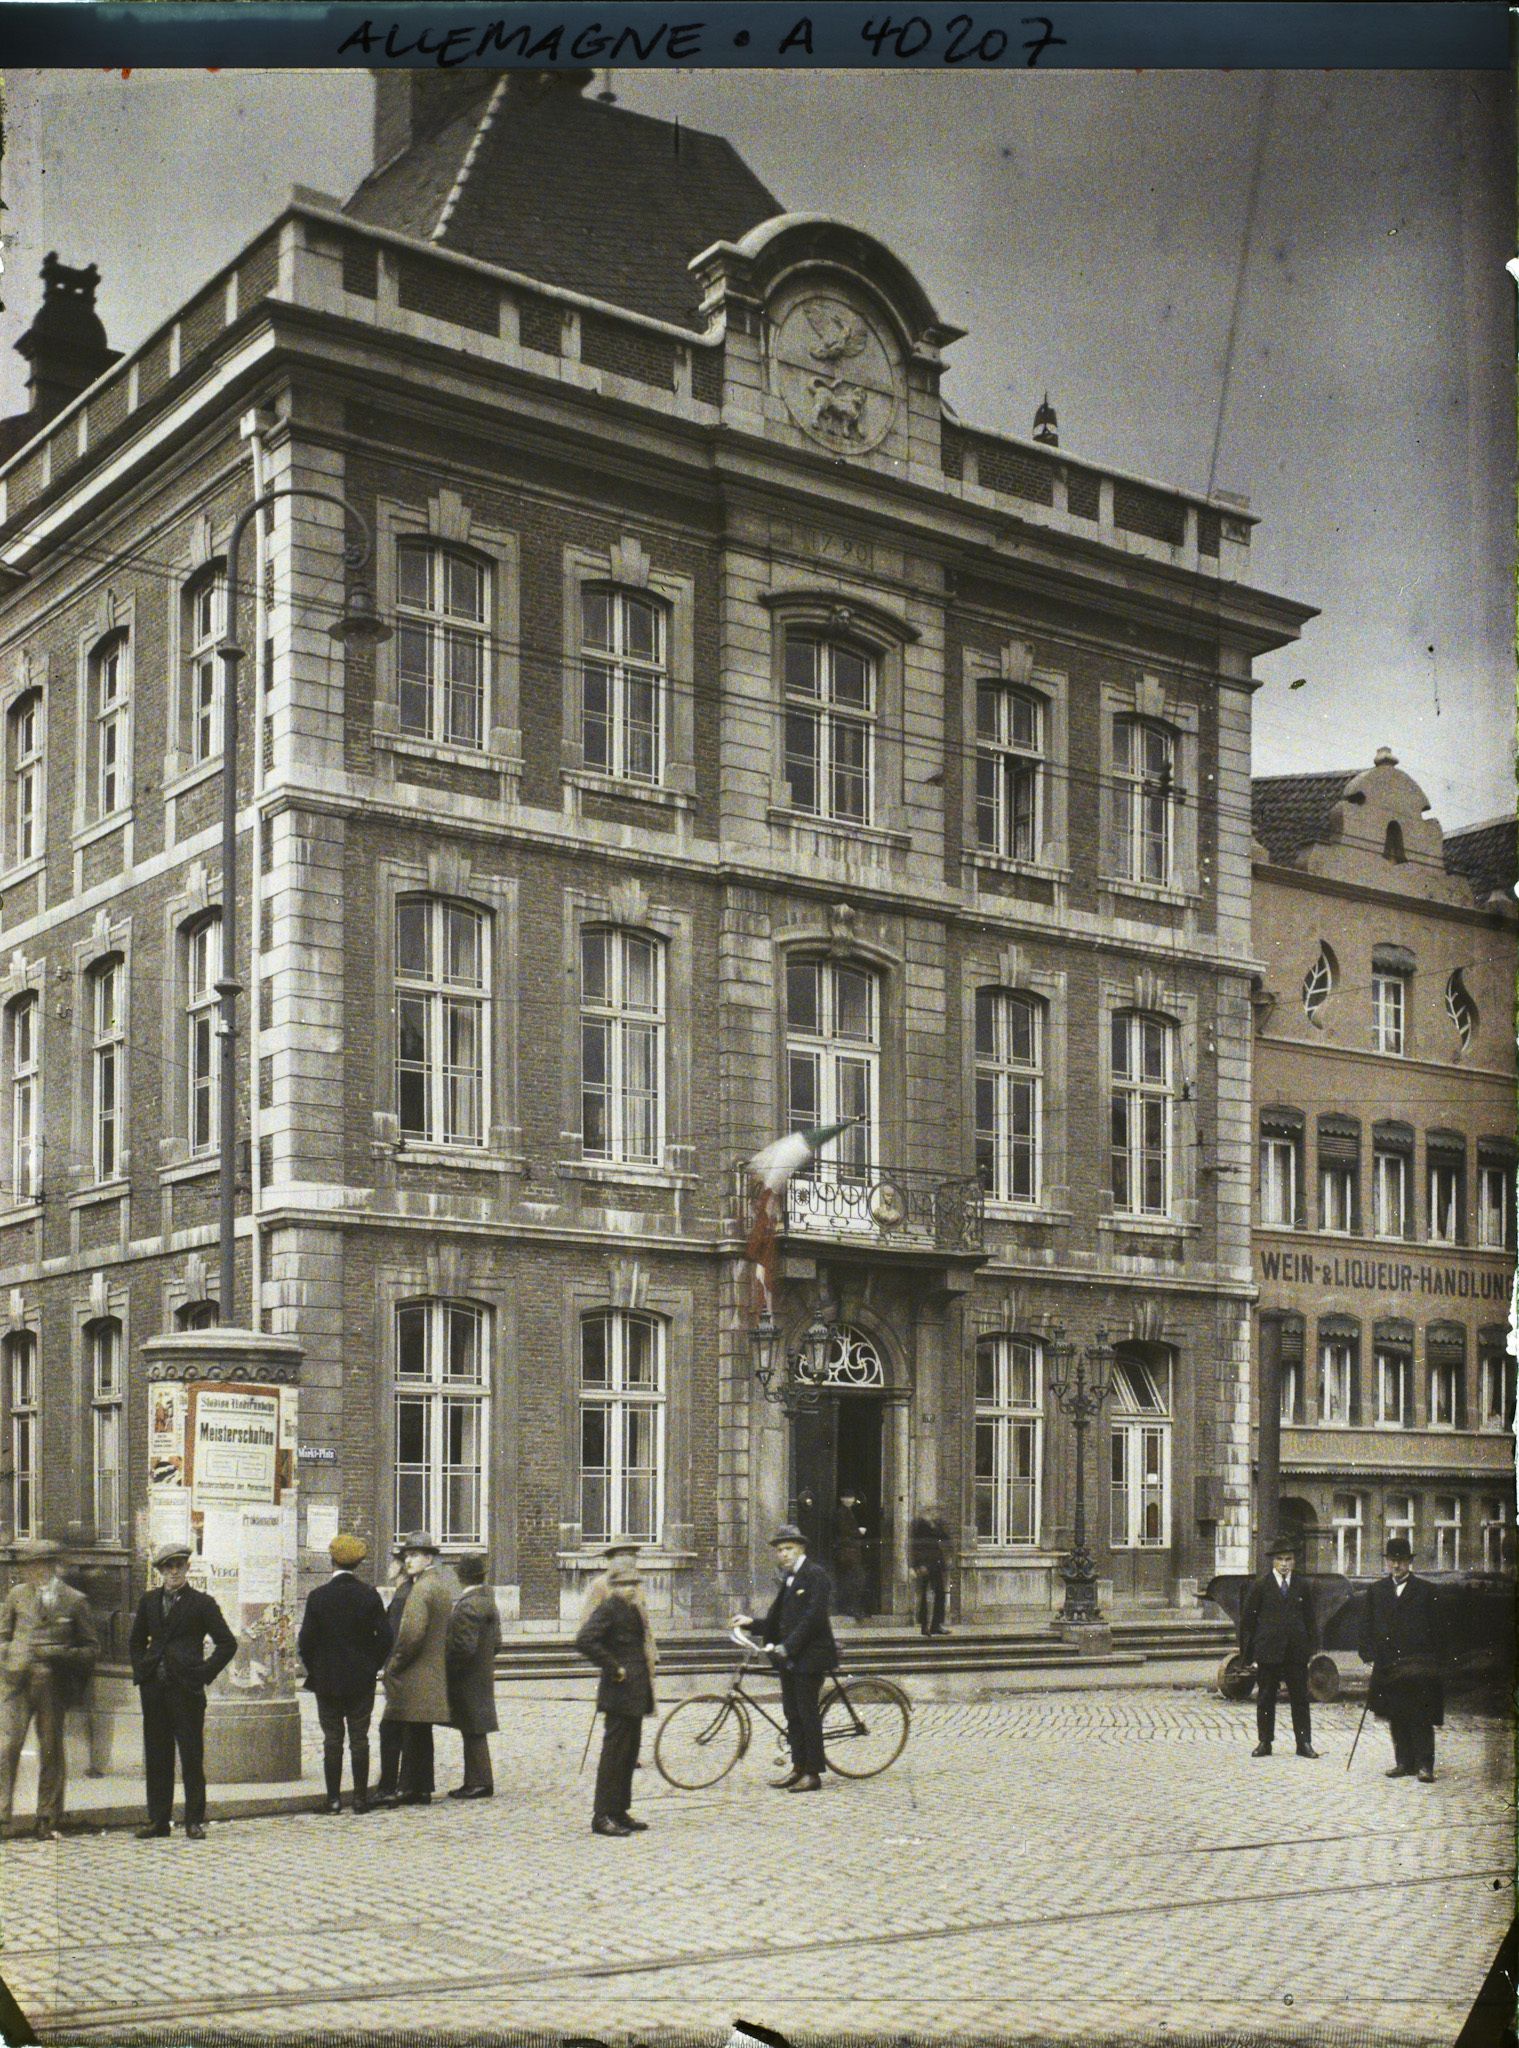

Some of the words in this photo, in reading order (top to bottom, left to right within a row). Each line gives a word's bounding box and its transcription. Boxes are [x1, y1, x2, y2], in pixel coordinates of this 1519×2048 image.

[338, 20, 708, 68] ALLEMAGNE
[778, 21, 814, 54] A
[861, 17, 1067, 66] 40207
[1260, 1250, 1321, 1283] WEIN-
[200, 1422, 274, 1445] Meisterschaften
